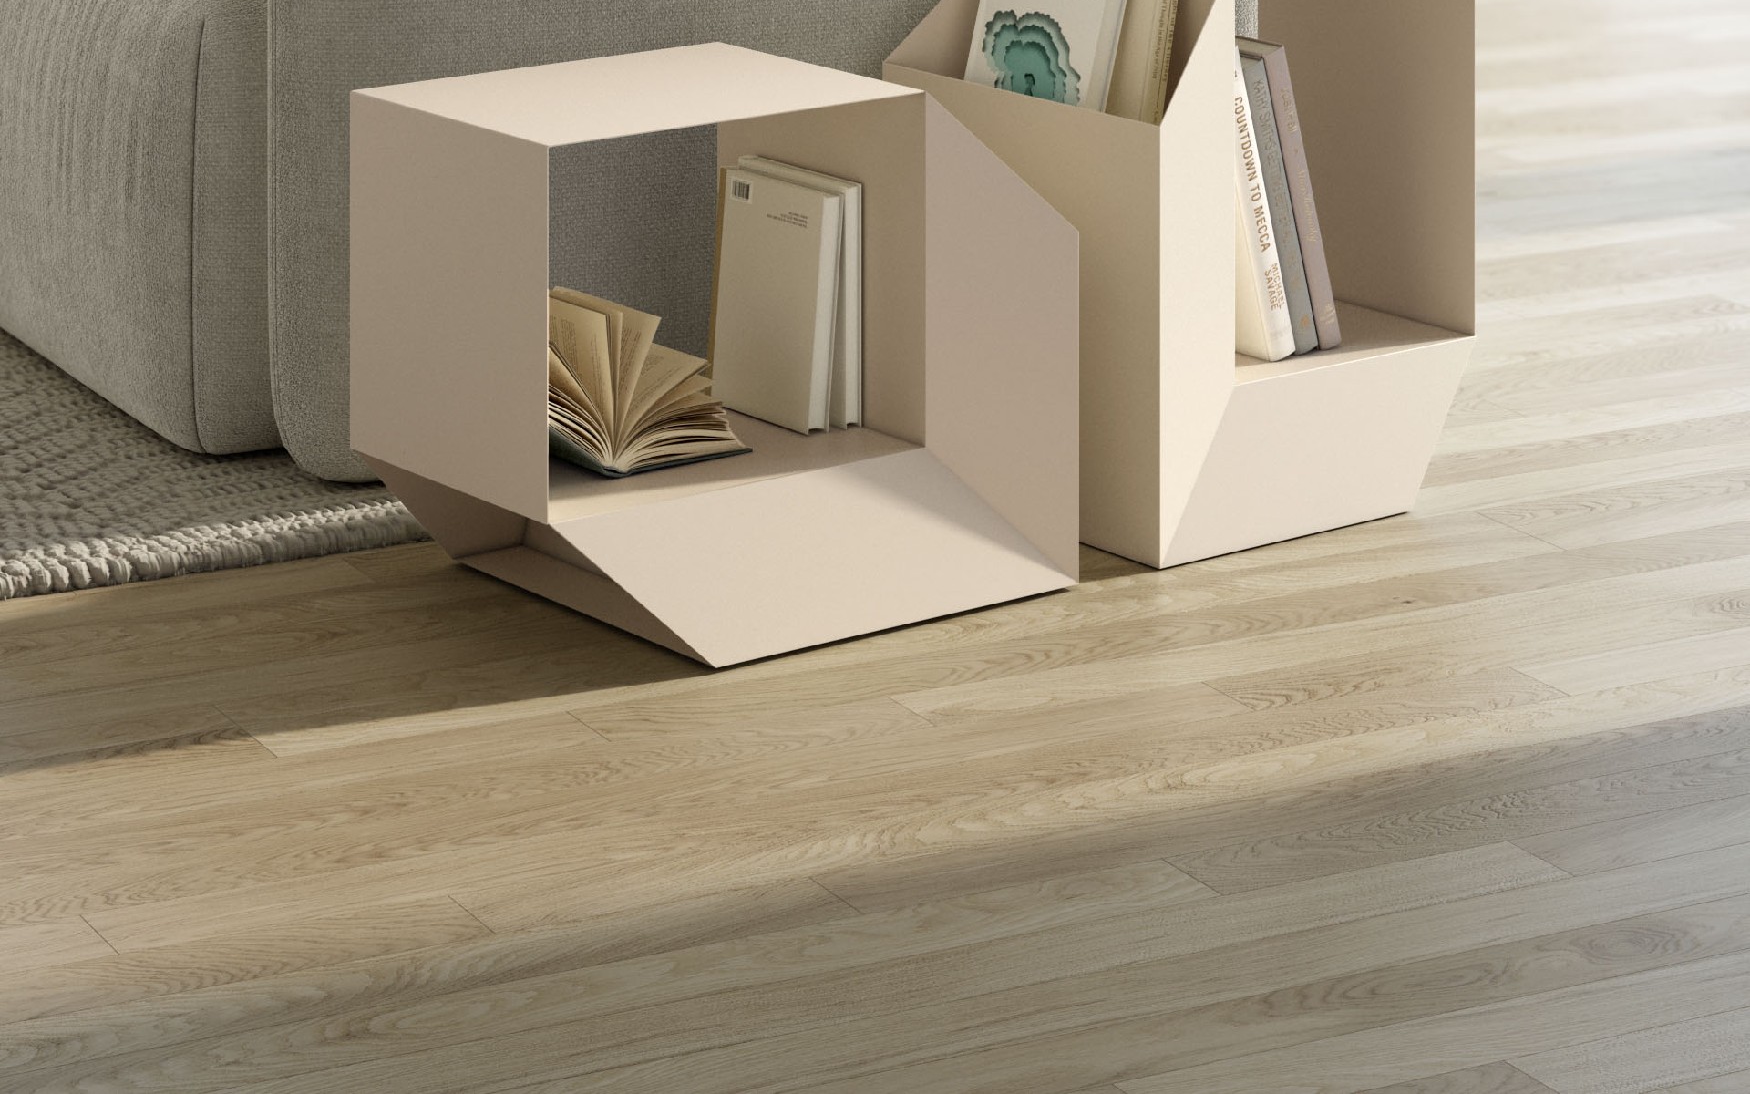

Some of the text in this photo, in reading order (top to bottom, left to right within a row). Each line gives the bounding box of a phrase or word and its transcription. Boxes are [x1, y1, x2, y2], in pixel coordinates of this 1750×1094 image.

[1235, 96, 1271, 253] COUNTDOWN TO MECCA
[1264, 270, 1279, 311] SAVAGE
[1271, 263, 1284, 310] MICHAEL
